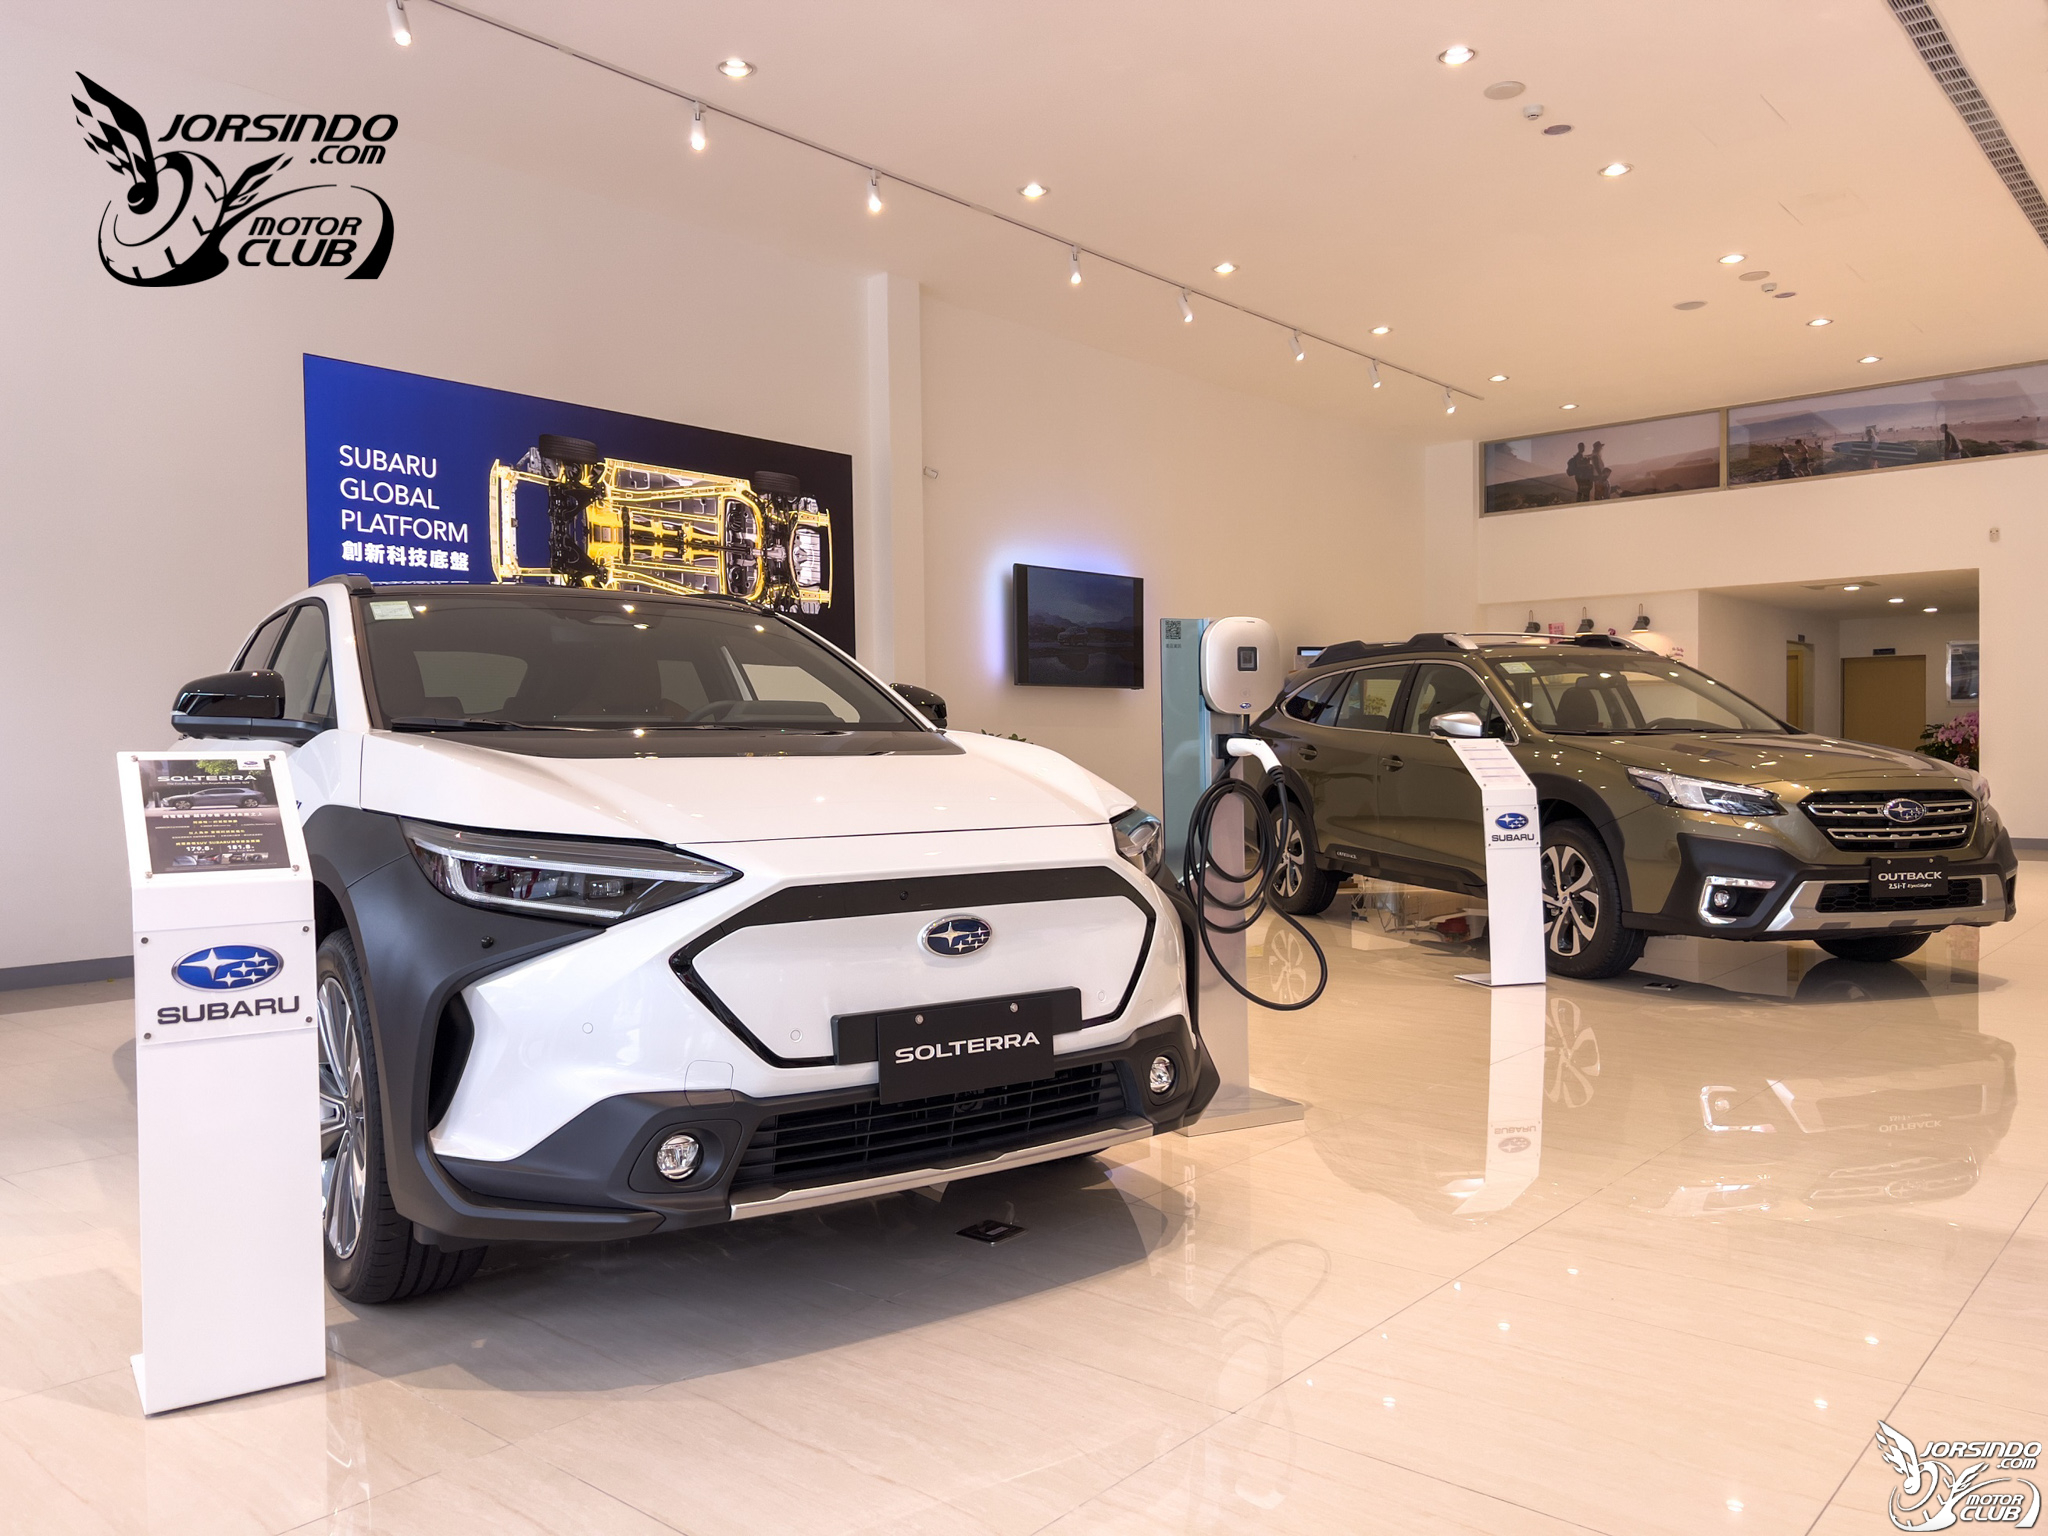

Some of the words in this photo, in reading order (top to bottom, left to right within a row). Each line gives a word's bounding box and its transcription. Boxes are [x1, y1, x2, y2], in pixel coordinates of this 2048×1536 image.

[339, 444, 437, 479] SUBARU
[339, 477, 440, 510] GLOBAL
[341, 509, 469, 544] PLATFORM
[341, 540, 470, 572] 創新科技底盤
[157, 774, 257, 783] SOLTERRA
[1491, 833, 1535, 842] SUBARU
[1878, 871, 1942, 881] OUTBACK
[157, 995, 300, 1025] SUBARU
[894, 1031, 1041, 1064] SOLTERRA
